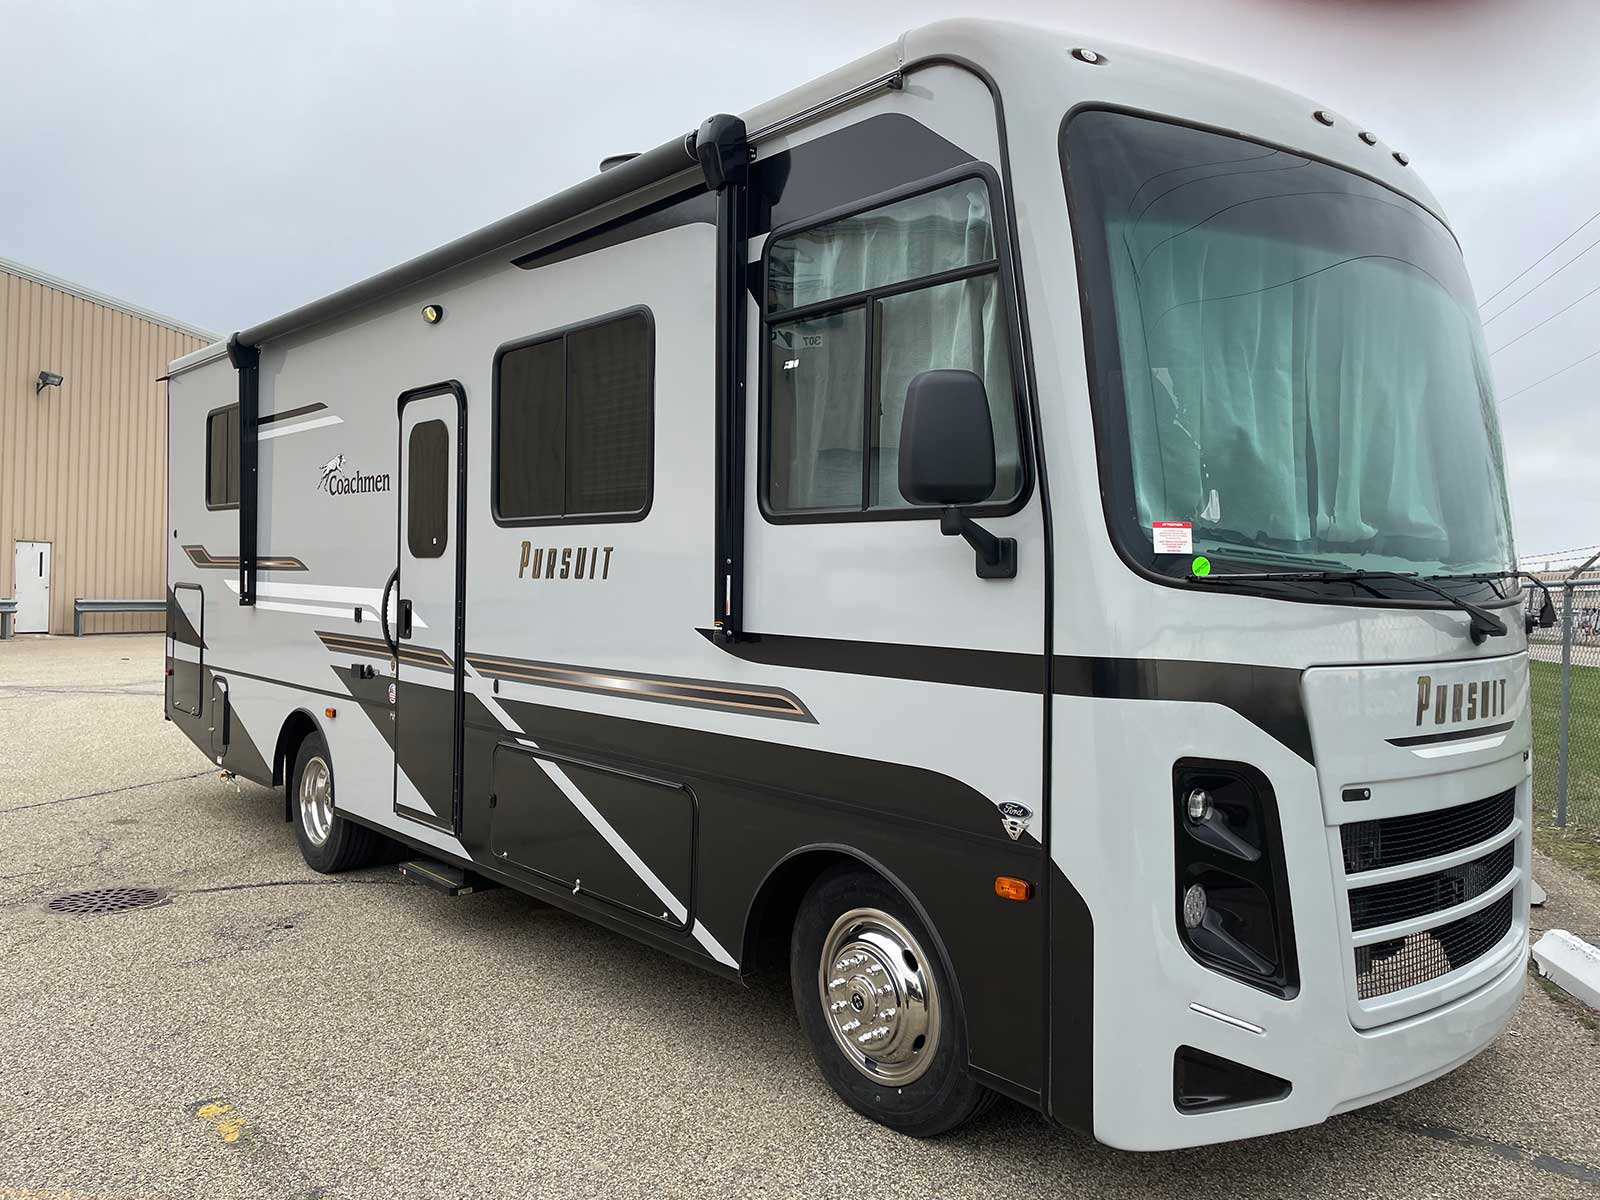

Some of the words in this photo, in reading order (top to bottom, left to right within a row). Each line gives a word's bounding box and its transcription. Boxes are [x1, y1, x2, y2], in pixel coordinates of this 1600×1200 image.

[329, 470, 390, 496] Coachmen
[518, 540, 614, 580] PURSUIT
[1416, 675, 1506, 726] PURSUIT
[1003, 802, 1024, 817] Ford
